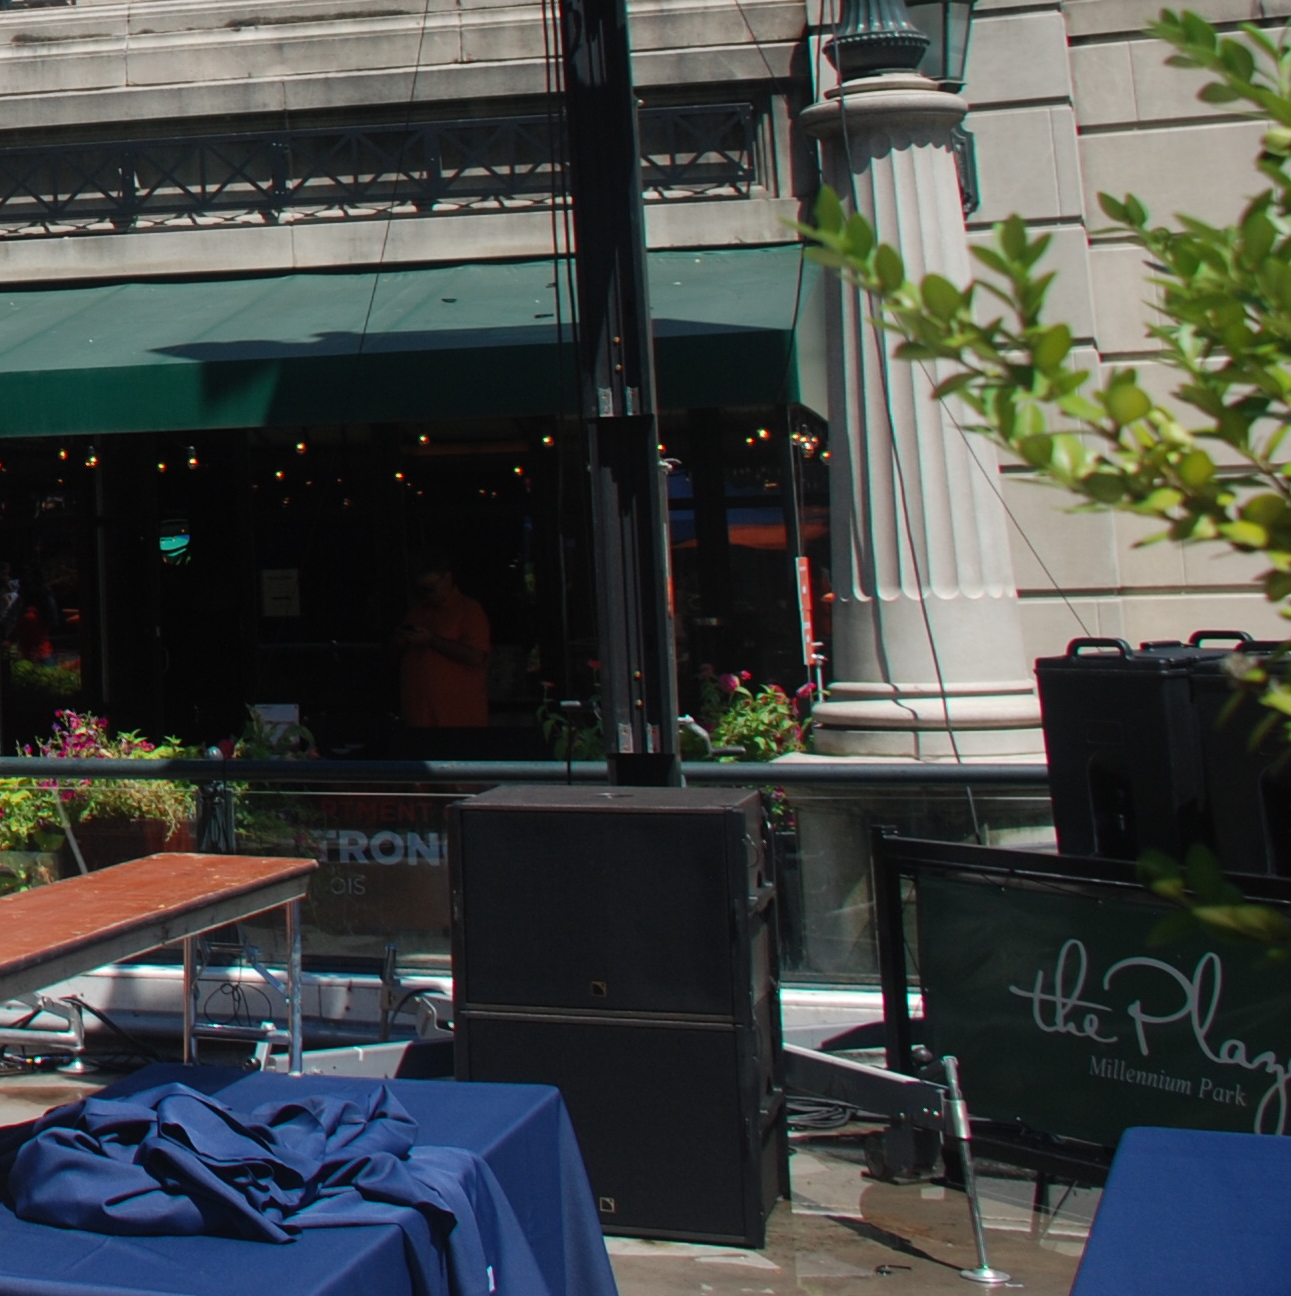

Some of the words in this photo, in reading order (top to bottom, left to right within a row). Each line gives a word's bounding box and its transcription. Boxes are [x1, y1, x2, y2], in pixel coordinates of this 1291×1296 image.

[310, 829, 449, 866] TRON
[1008, 938, 1119, 1044] the
[1102, 951, 1291, 1135] Plaz
[1088, 1055, 1193, 1096] Millennium
[1198, 1077, 1248, 1107] Park
